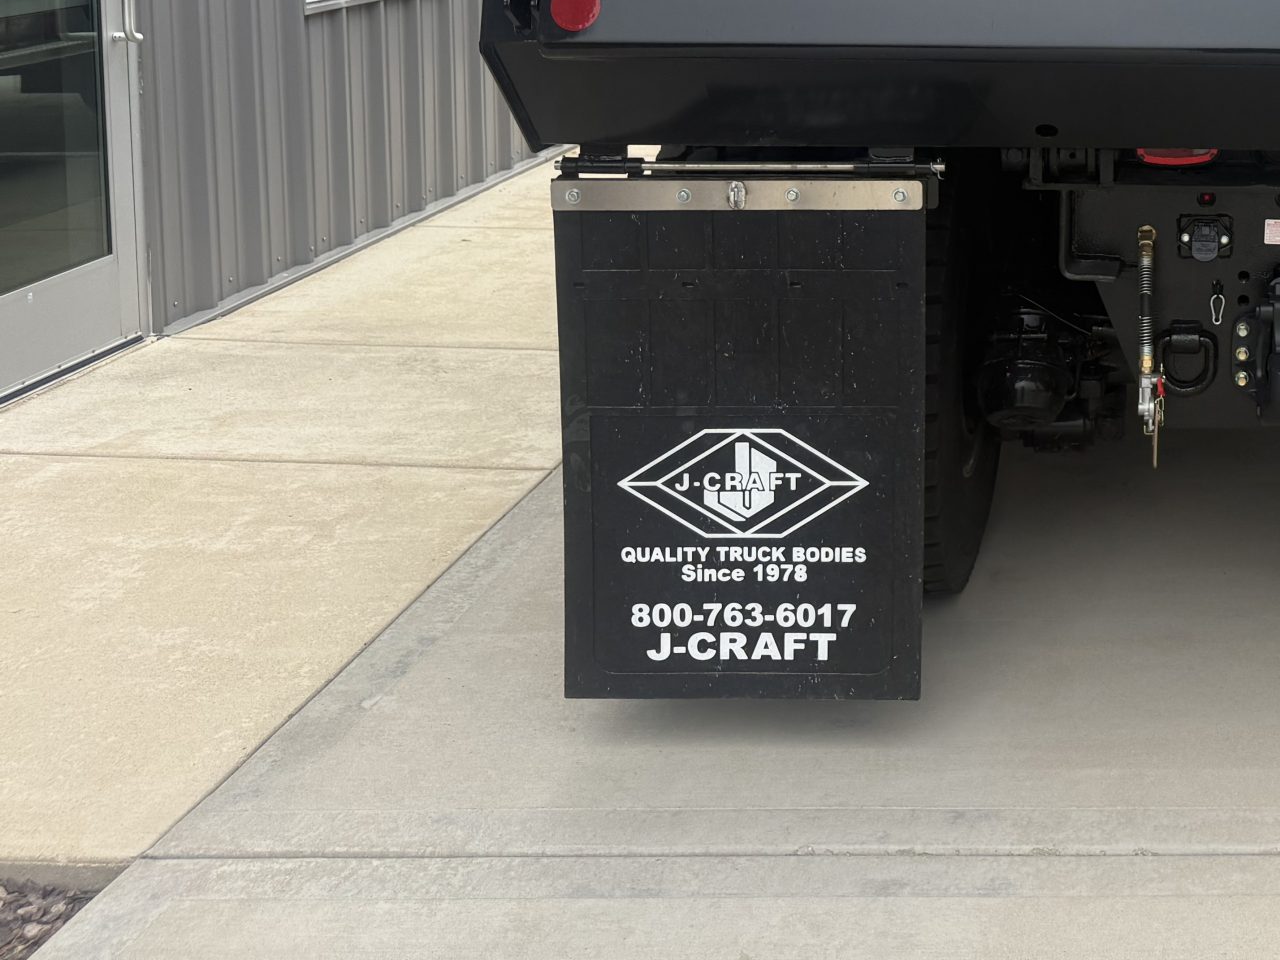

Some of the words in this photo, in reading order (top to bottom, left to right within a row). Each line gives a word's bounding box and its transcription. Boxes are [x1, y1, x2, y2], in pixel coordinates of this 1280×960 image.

[674, 472, 802, 492] J-CRAFT
[620, 546, 711, 564] QUALITY
[716, 546, 786, 563] TRUCK
[791, 546, 868, 563] BODIES
[681, 564, 746, 582] Since
[752, 564, 808, 582] 1978
[631, 602, 857, 628] 800-763-6017
[646, 631, 837, 661] J-CRAFT
